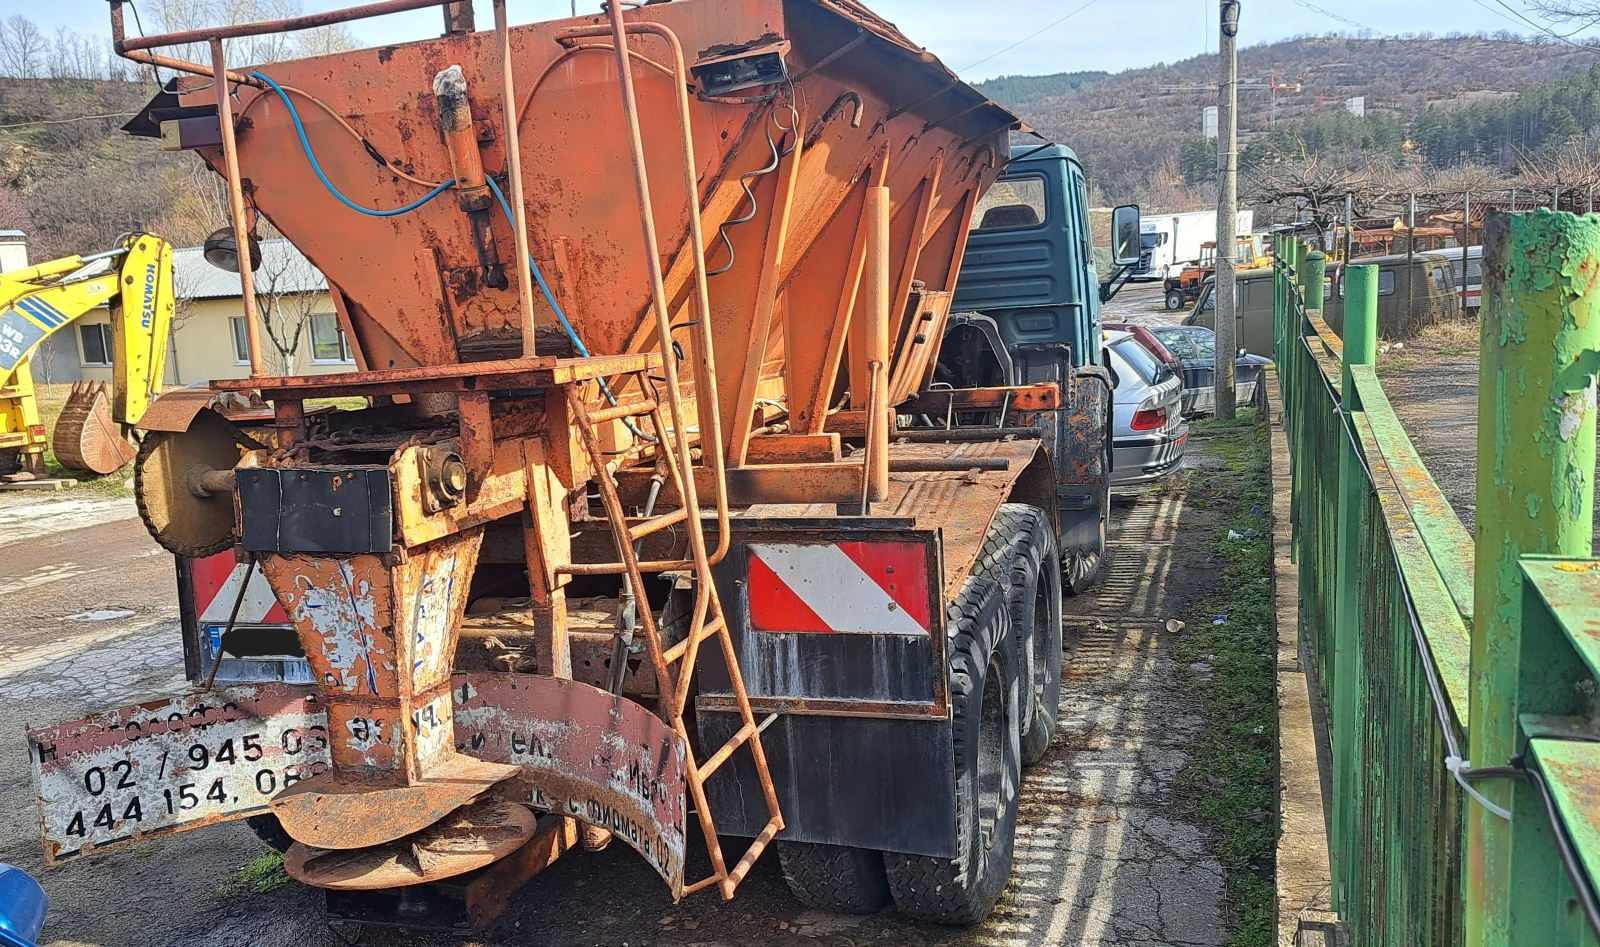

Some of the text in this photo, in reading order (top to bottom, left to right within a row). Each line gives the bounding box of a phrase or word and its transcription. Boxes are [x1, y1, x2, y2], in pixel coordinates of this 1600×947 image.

[141, 263, 156, 329] KOMATSU
[0, 333, 21, 359] 3R
[2, 323, 24, 343] WB
[84, 760, 137, 797] 02
[188, 734, 264, 771] 945
[65, 796, 144, 838] 444
